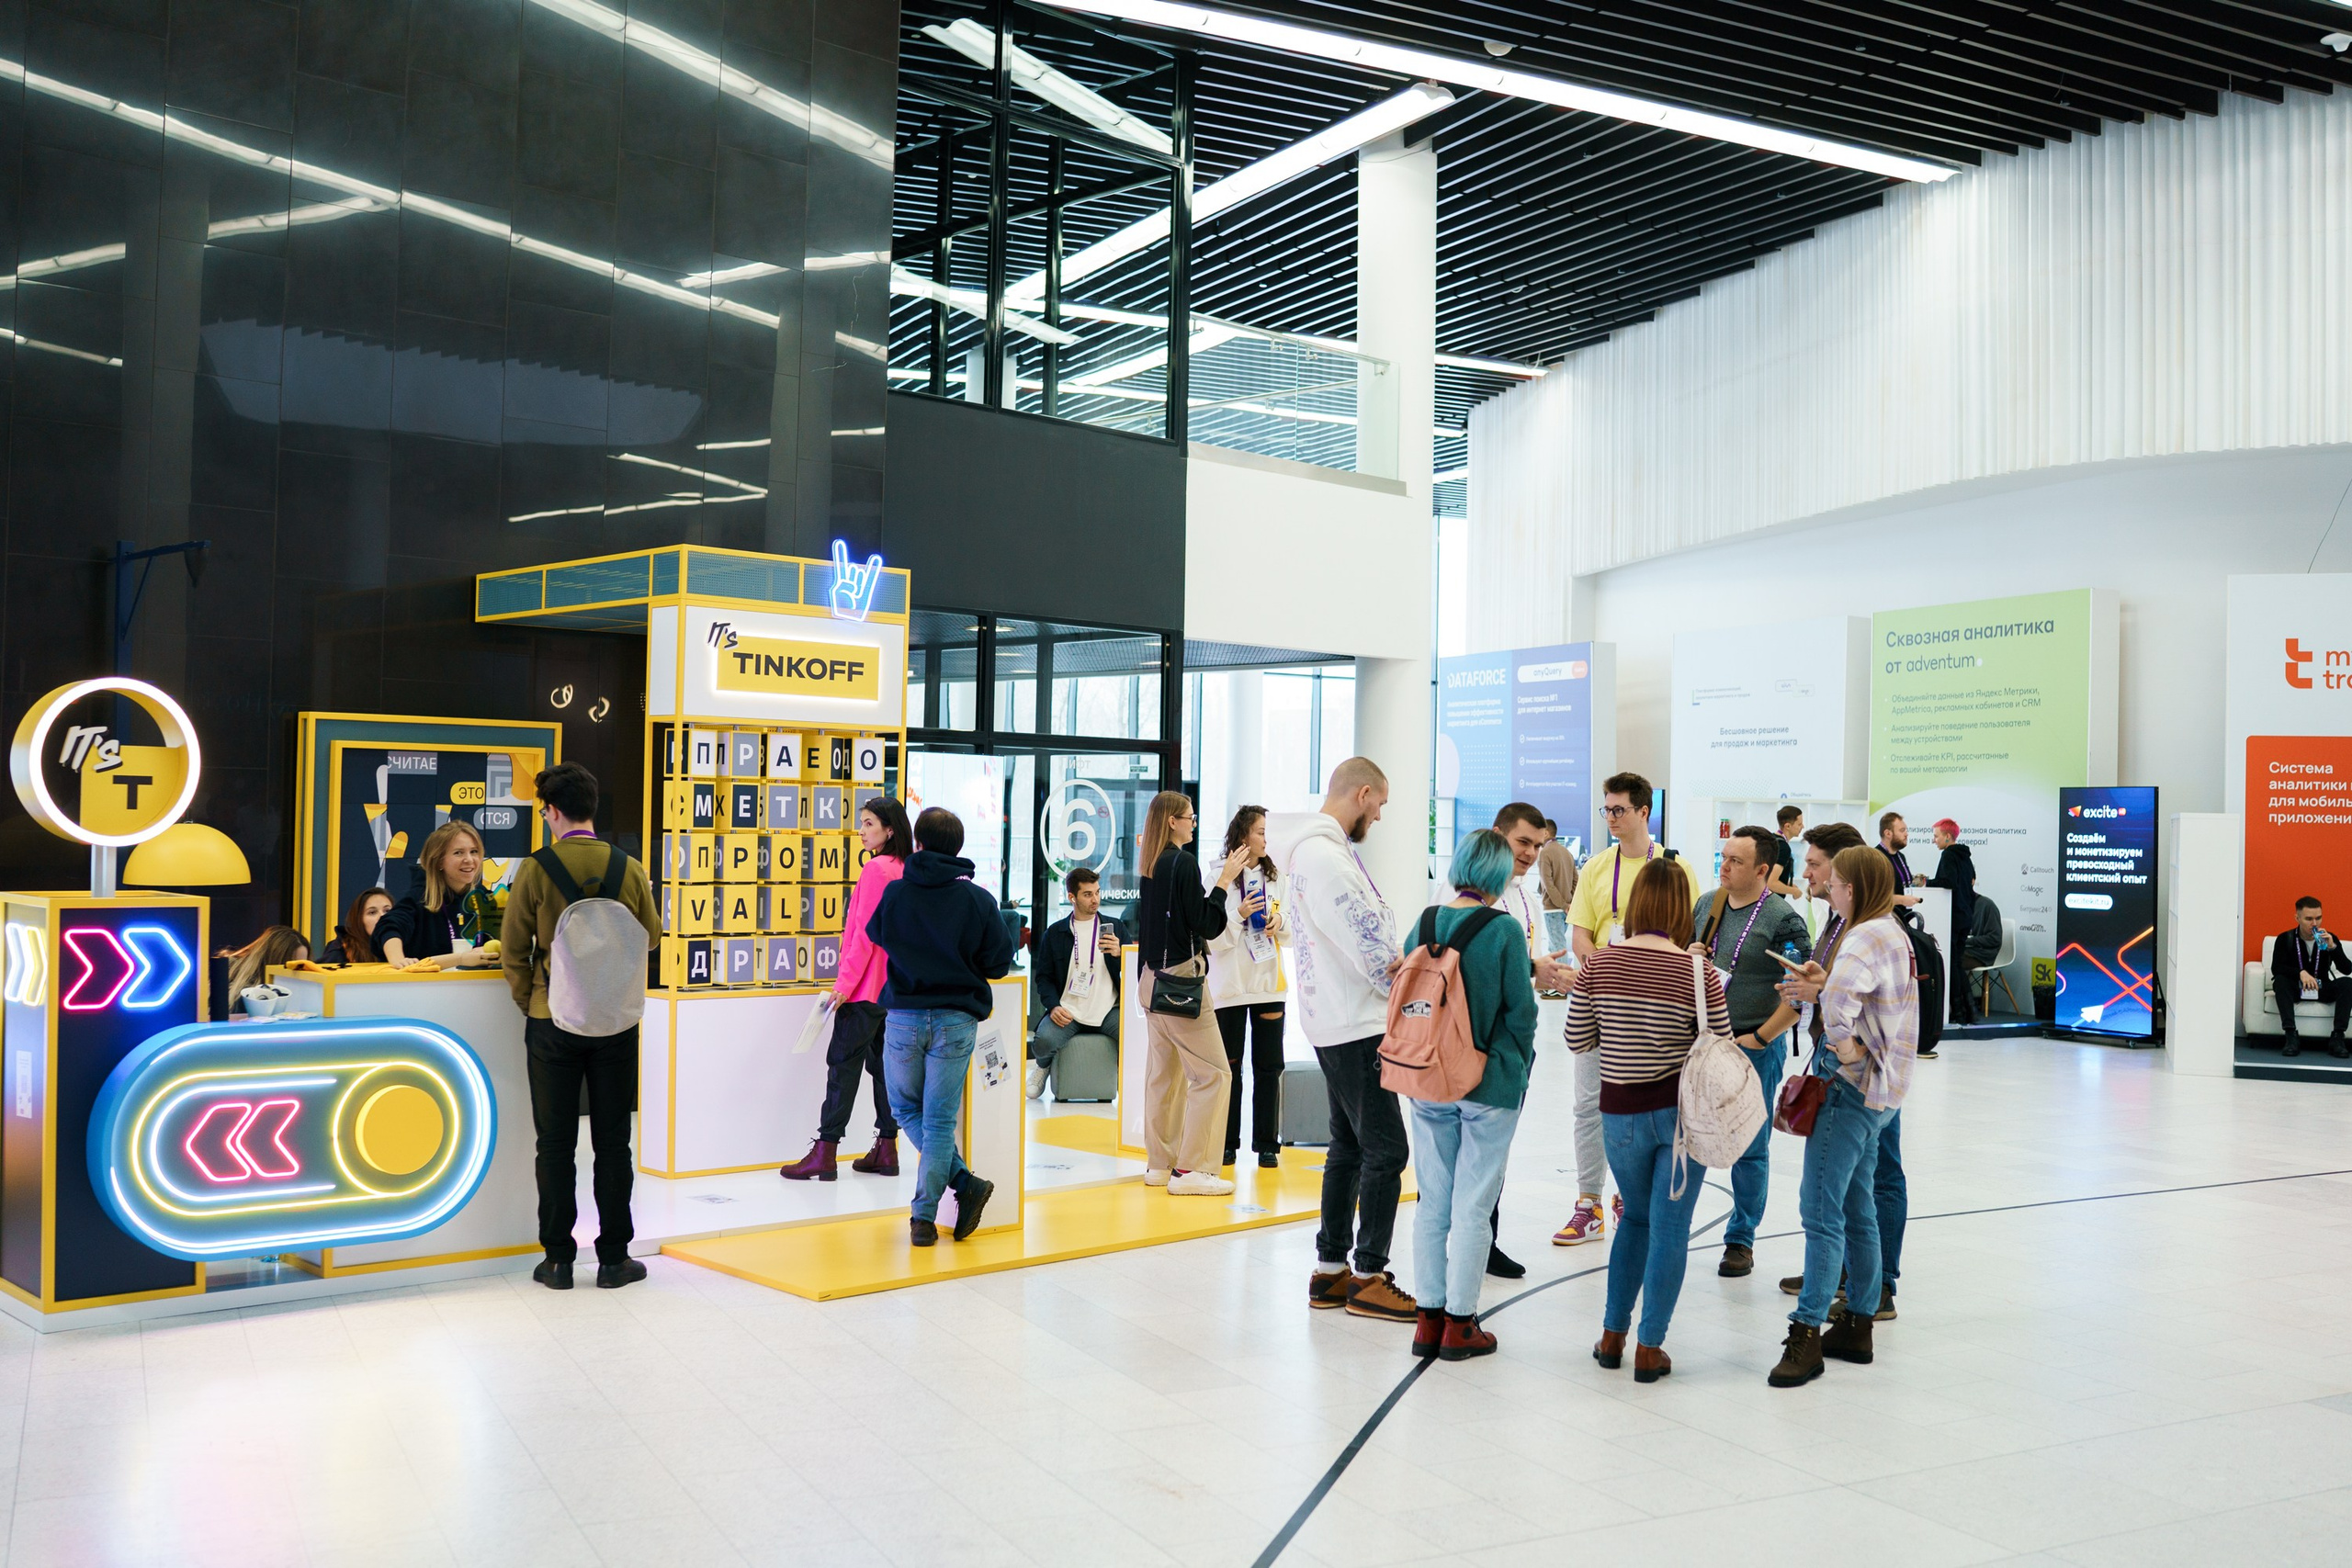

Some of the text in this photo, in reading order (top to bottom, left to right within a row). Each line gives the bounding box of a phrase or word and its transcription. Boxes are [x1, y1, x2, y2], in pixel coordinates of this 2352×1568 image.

[1886, 620, 2054, 648] Сквозная аналитика
[1885, 653, 1974, 673] от adventum
[2325, 650, 2352, 666] m
[732, 651, 865, 682] TINKOFF
[1447, 668, 1506, 688] DATAFORCE
[1533, 668, 1562, 678] anyQuery
[1938, 692, 1964, 701] данные
[1975, 689, 2003, 697] Яндекс
[1975, 701, 2014, 710] кабинетов
[2021, 698, 2041, 707] CRM
[1758, 727, 1790, 736] решение
[1940, 723, 1978, 731] поведение
[1979, 720, 2030, 728] пользователя
[1756, 739, 1798, 748] маркетинга
[1914, 735, 1963, 745] устройствами
[1956, 753, 2009, 761] рассчитанные
[2268, 761, 2334, 774] Система
[2268, 780, 2347, 791] аналитики
[113, 775, 153, 809] T
[458, 787, 484, 799] ЭТО
[2268, 796, 2296, 807] для
[2083, 805, 2118, 818] excite
[2268, 813, 2352, 826] приложени
[1059, 798, 1097, 861] 6
[1958, 838, 1988, 846] ерверах!
[2066, 832, 2107, 844] Создаём
[2066, 847, 2143, 859] и монетизируем
[2065, 860, 2135, 871] превосходный
[2065, 873, 2148, 885] клиентский опыт
[2035, 963, 2052, 982] Sk
